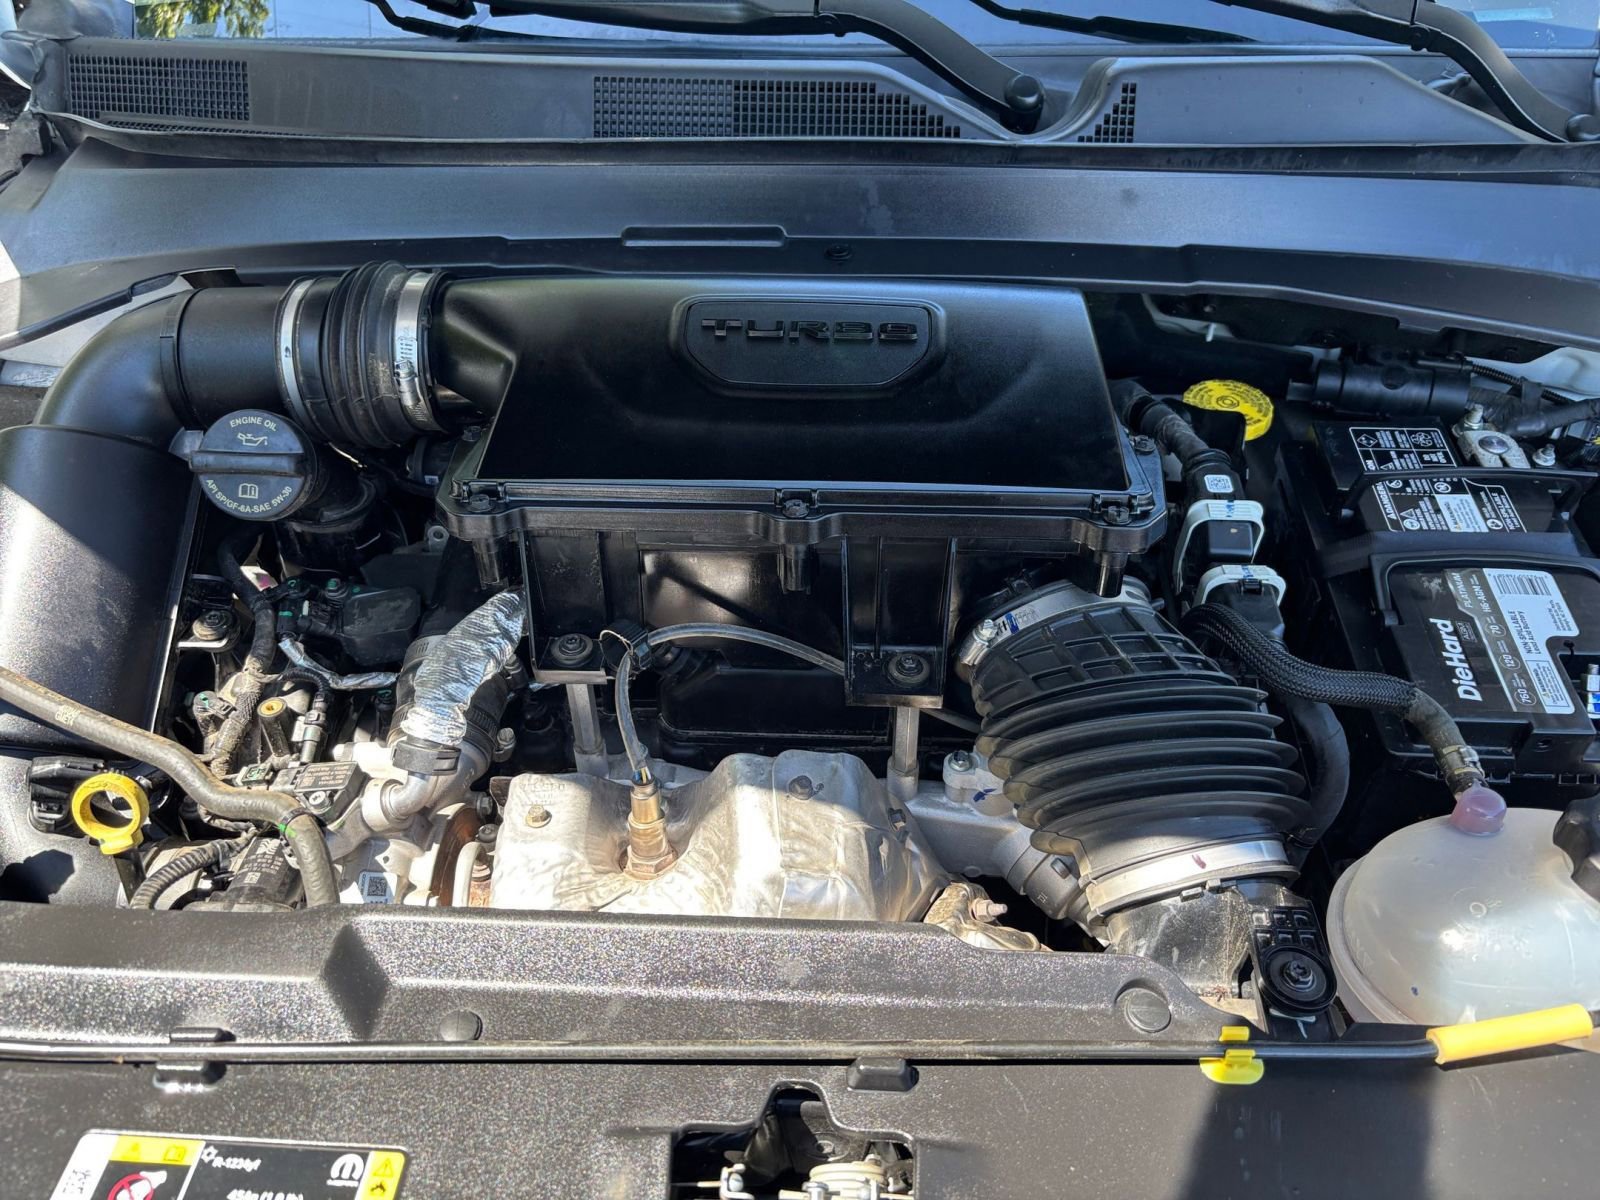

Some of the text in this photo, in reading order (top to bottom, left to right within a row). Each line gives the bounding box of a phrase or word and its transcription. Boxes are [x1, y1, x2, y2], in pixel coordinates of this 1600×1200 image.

[701, 319, 918, 341] TURBO
[229, 416, 278, 432] ENGINE OIL
[206, 479, 219, 495] API
[271, 485, 293, 508] 5W-30
[1451, 572, 1473, 609] PLATINUM
[1489, 625, 1502, 635] 70
[1508, 610, 1532, 654] NON-SPILLABLE
[1516, 610, 1542, 655] Lead Acid Battery
[1430, 618, 1483, 702] DieHard
[1502, 654, 1516, 668] 120
[1517, 688, 1532, 704] 760
